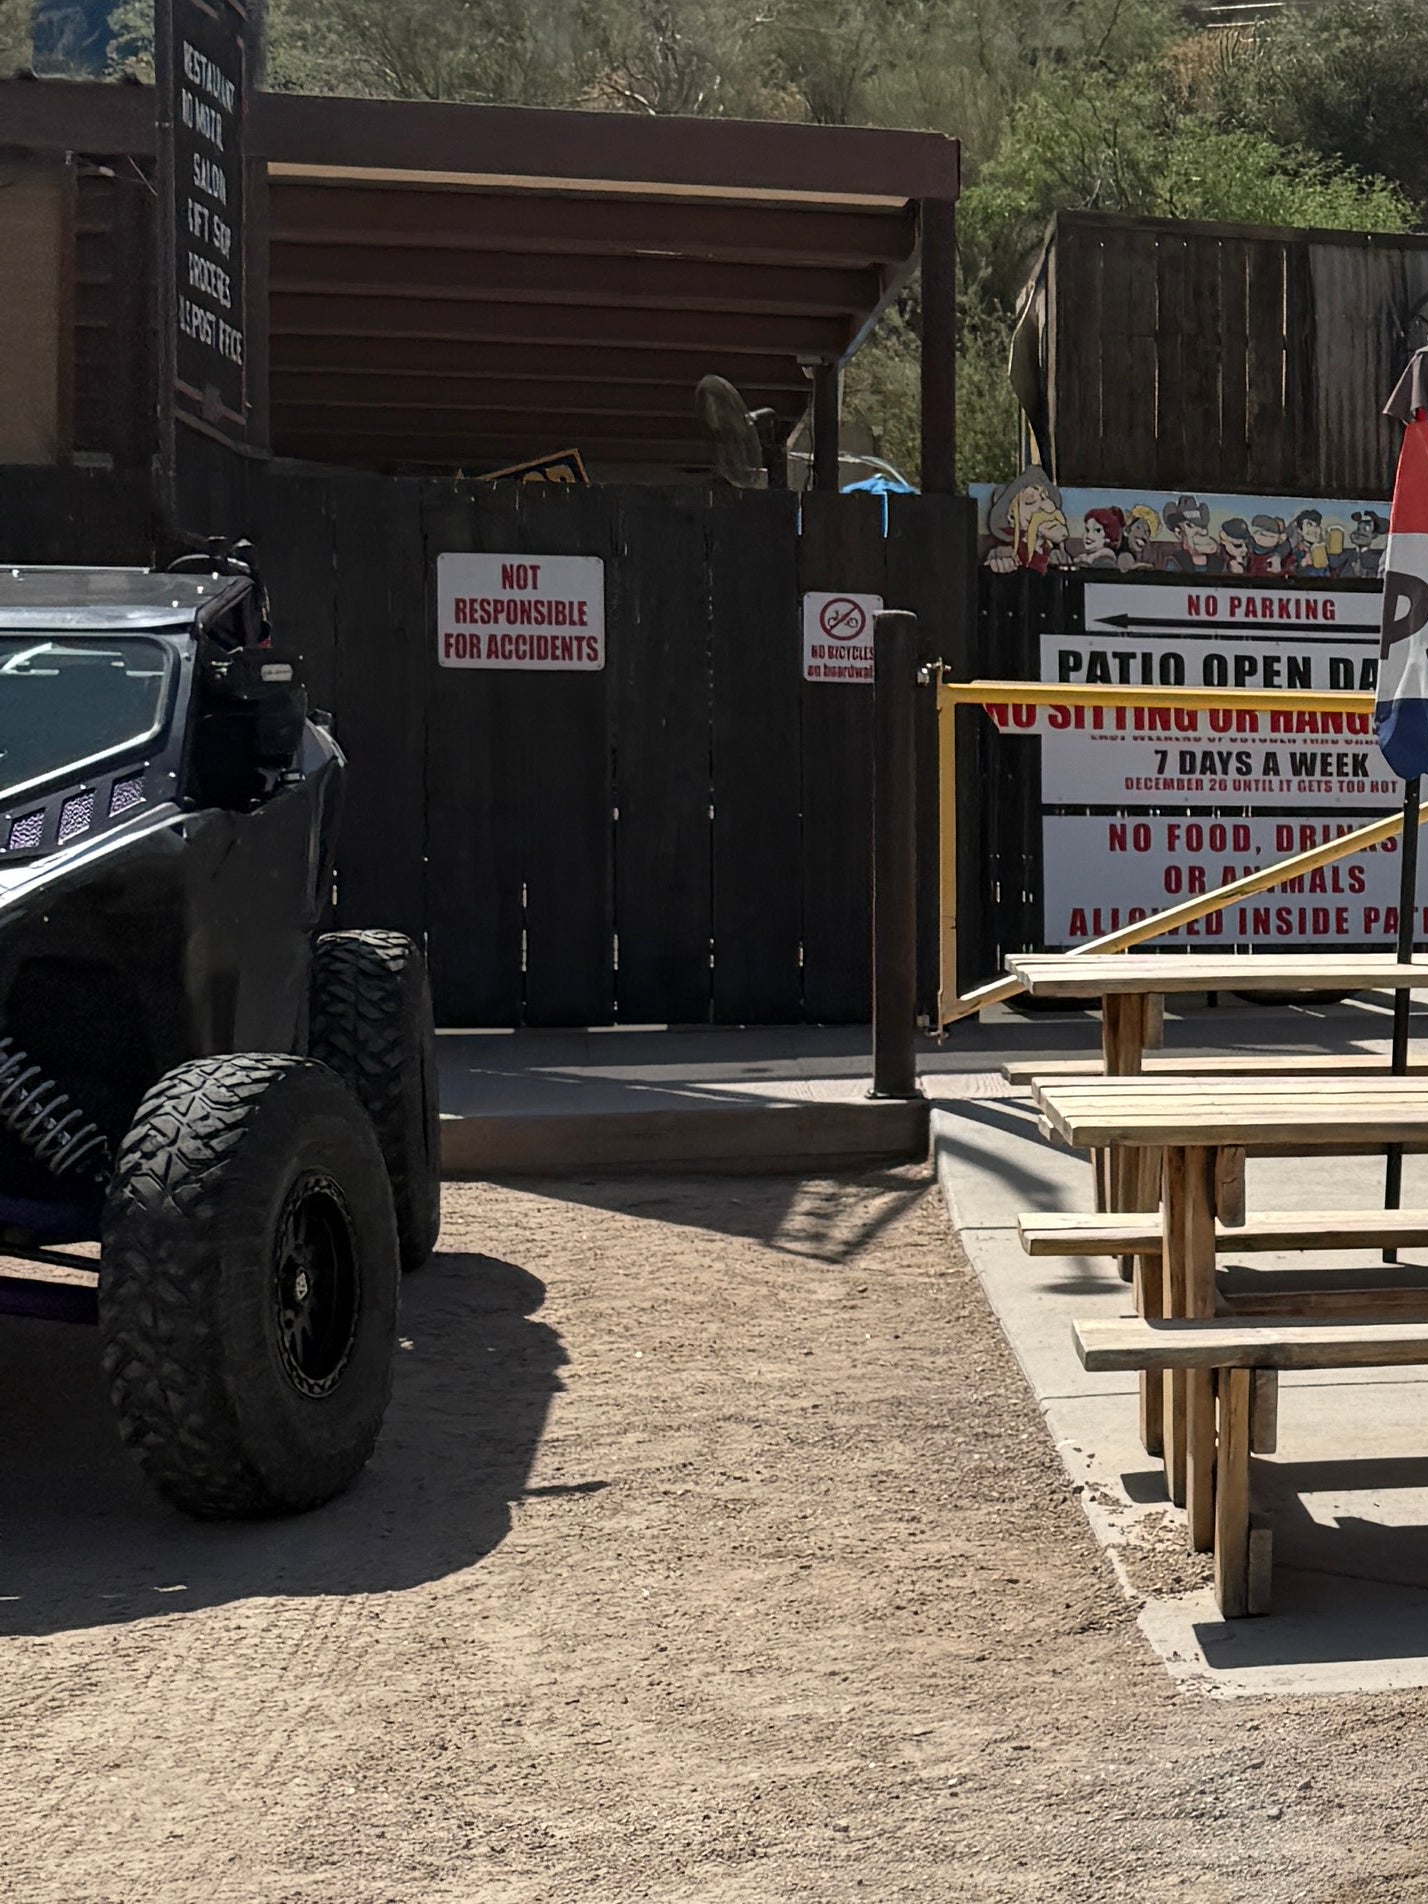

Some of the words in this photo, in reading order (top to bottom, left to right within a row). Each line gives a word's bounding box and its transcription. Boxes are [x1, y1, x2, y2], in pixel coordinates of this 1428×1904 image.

[501, 563, 541, 591] NOT
[454, 597, 588, 627] RESPONSIBLE
[1188, 594, 1219, 617] NO
[1229, 595, 1336, 622] PARKING
[444, 633, 481, 660] FOR
[487, 633, 599, 663] ACCIDENTS
[811, 644, 825, 658] NO
[828, 645, 874, 661] BICYCLES
[1058, 649, 1186, 686] PATIO
[1203, 653, 1311, 689] OPEN
[1154, 749, 1168, 775] 7
[1179, 750, 1252, 776] DAYS
[1262, 751, 1281, 776] A
[1289, 752, 1369, 777] WEEK
[1125, 776, 1204, 791] DECEMBER
[1232, 778, 1275, 792] UNTIL
[1278, 779, 1293, 792] IT
[1298, 780, 1332, 793] GETS
[1336, 780, 1366, 794] TOO
[1370, 780, 1398, 795] HOT
[1108, 823, 1152, 852] NO
[1167, 823, 1261, 856] FOOD,
[1164, 865, 1207, 895] OR
[1221, 865, 1367, 895] AMALS
[1239, 907, 1349, 936] INSIDE
